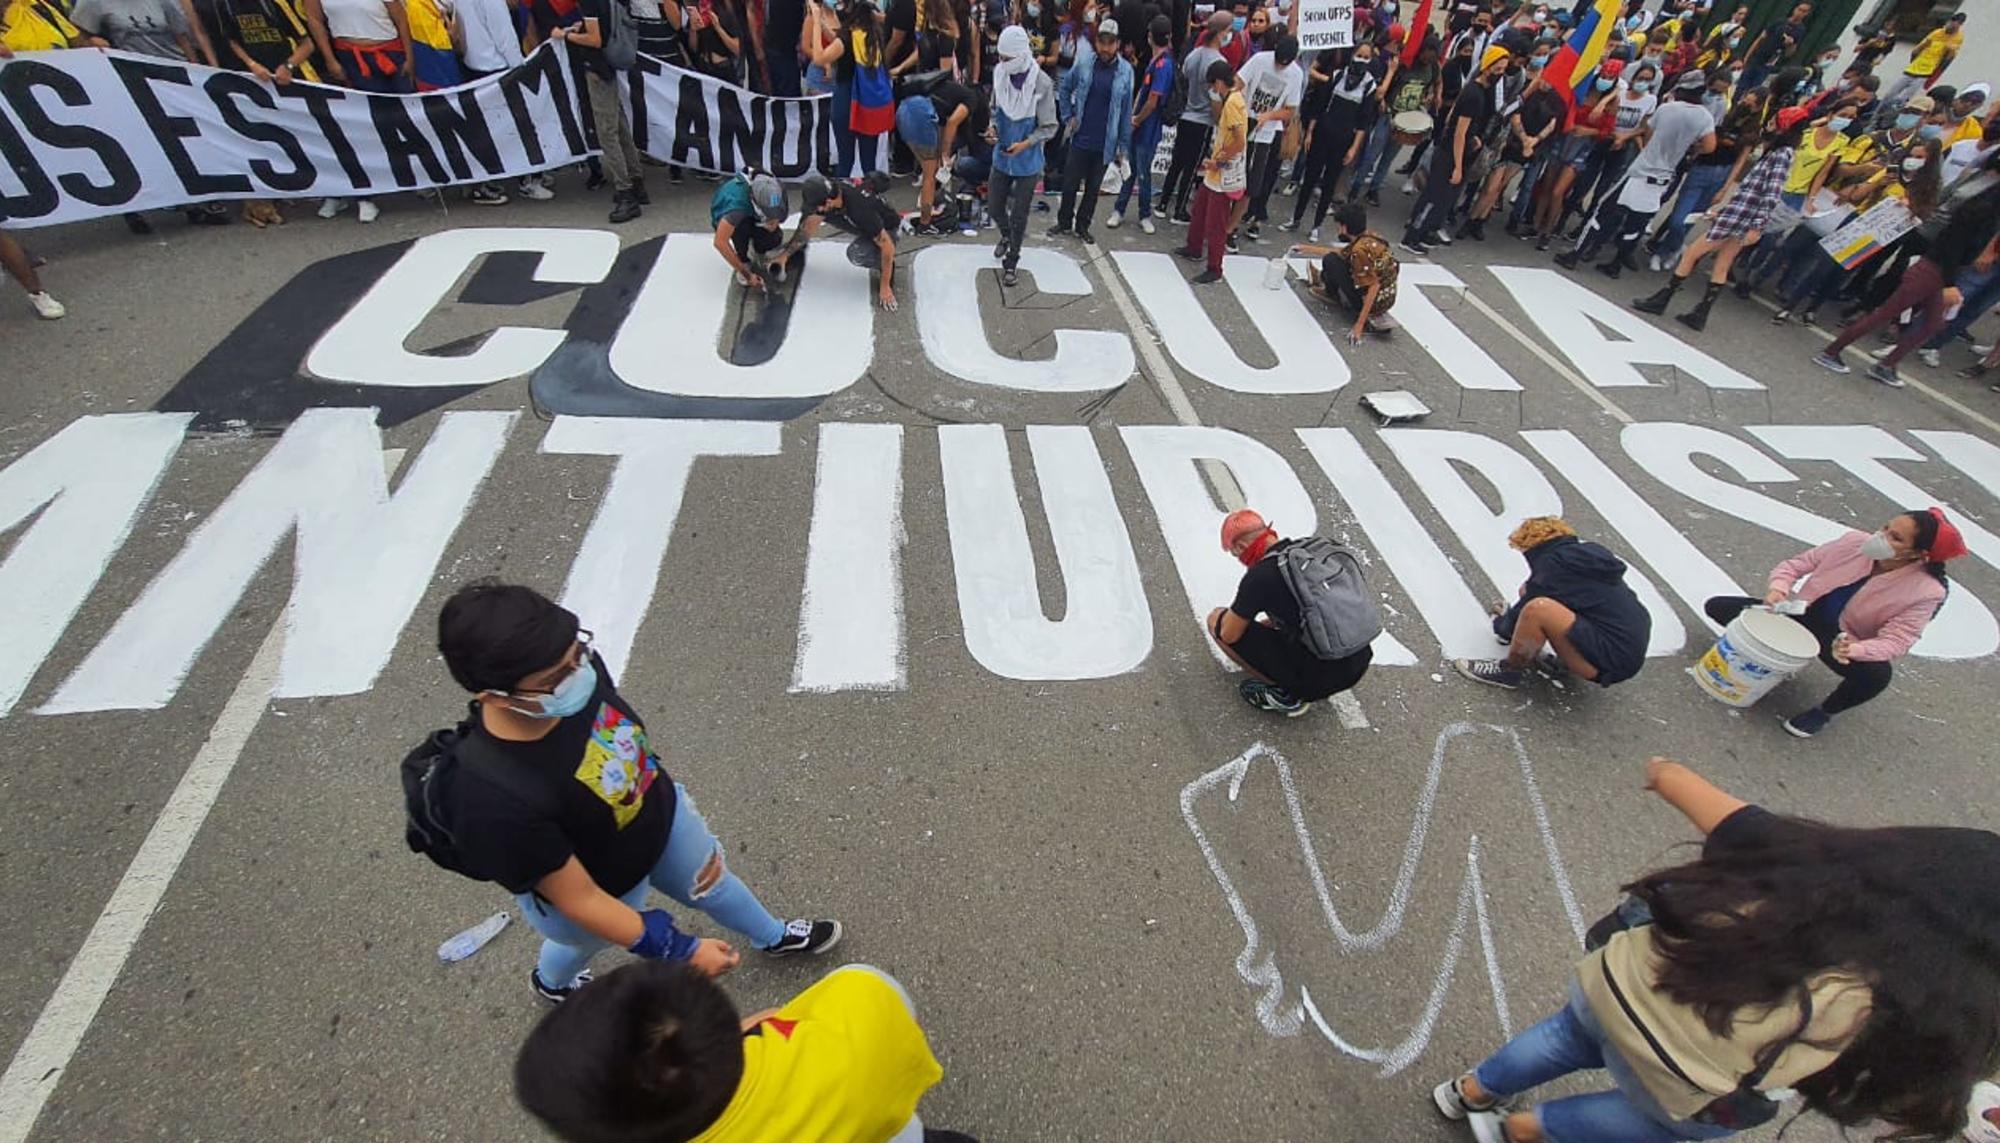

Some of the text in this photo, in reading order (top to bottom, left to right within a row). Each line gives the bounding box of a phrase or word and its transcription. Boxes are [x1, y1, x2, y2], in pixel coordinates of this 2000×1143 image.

[1328, 5, 1352, 20] UFPS
[1302, 31, 1347, 47] PRESENTE
[108, 57, 506, 196] ESTAN
